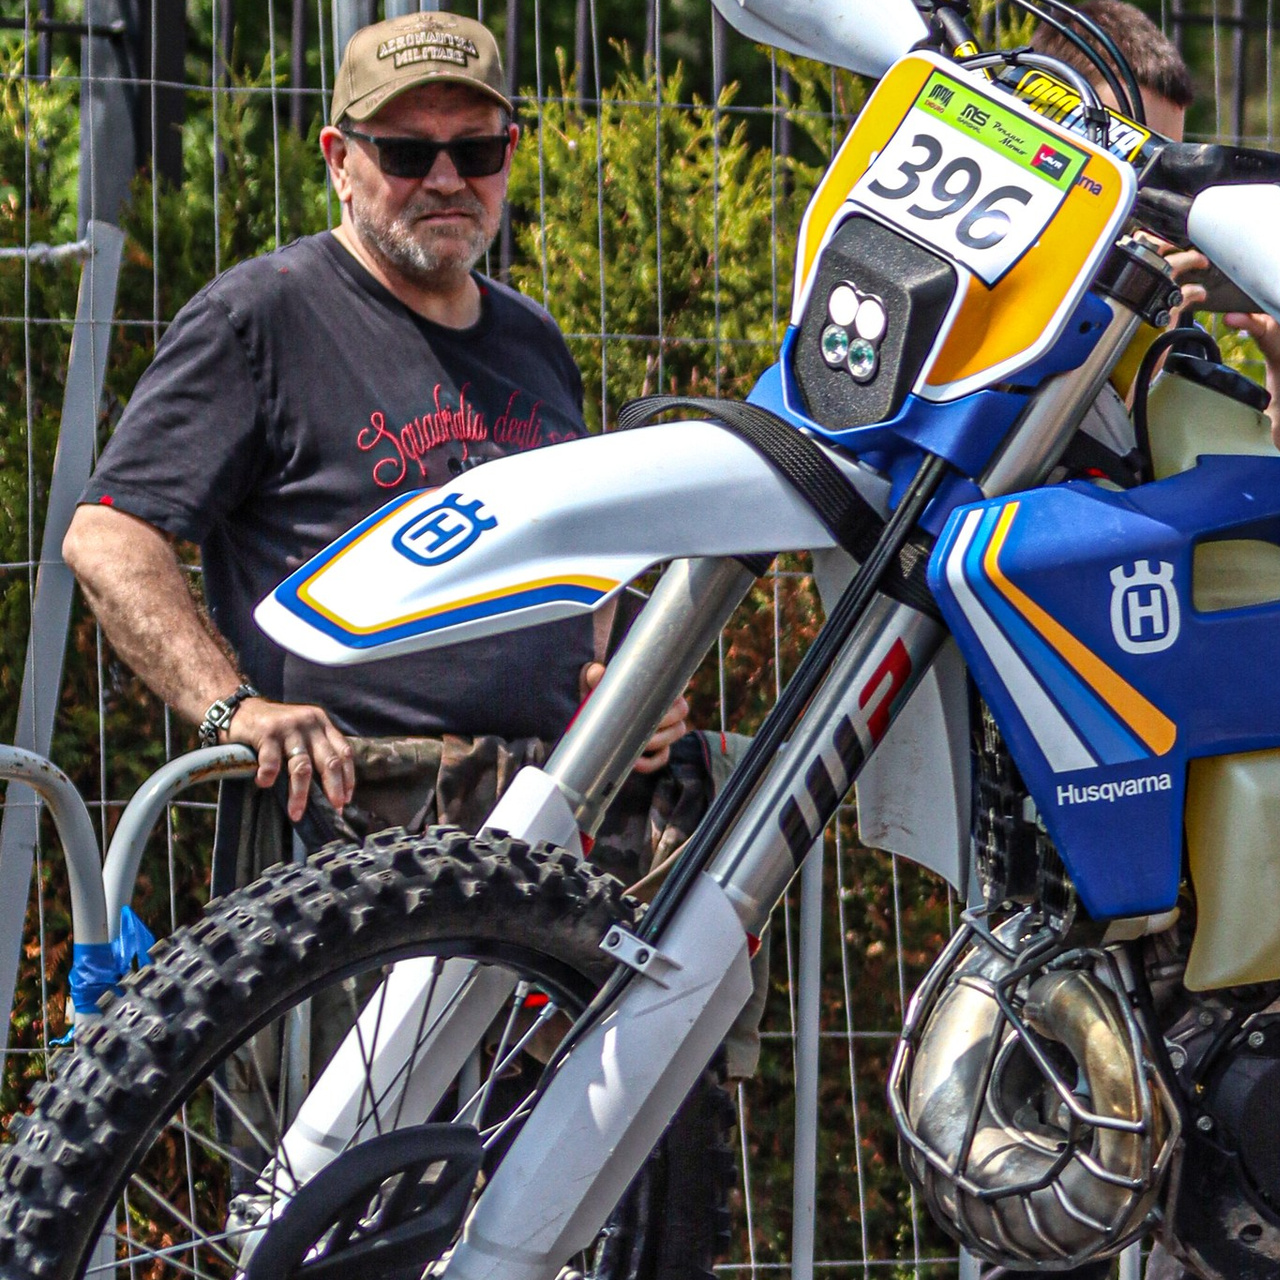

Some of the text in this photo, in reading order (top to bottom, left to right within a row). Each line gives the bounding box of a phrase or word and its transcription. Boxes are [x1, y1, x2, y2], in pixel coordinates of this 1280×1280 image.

[868, 133, 1033, 250] 396
[357, 382, 488, 488] Squadriglia
[1056, 772, 1172, 806] Husqvarna
